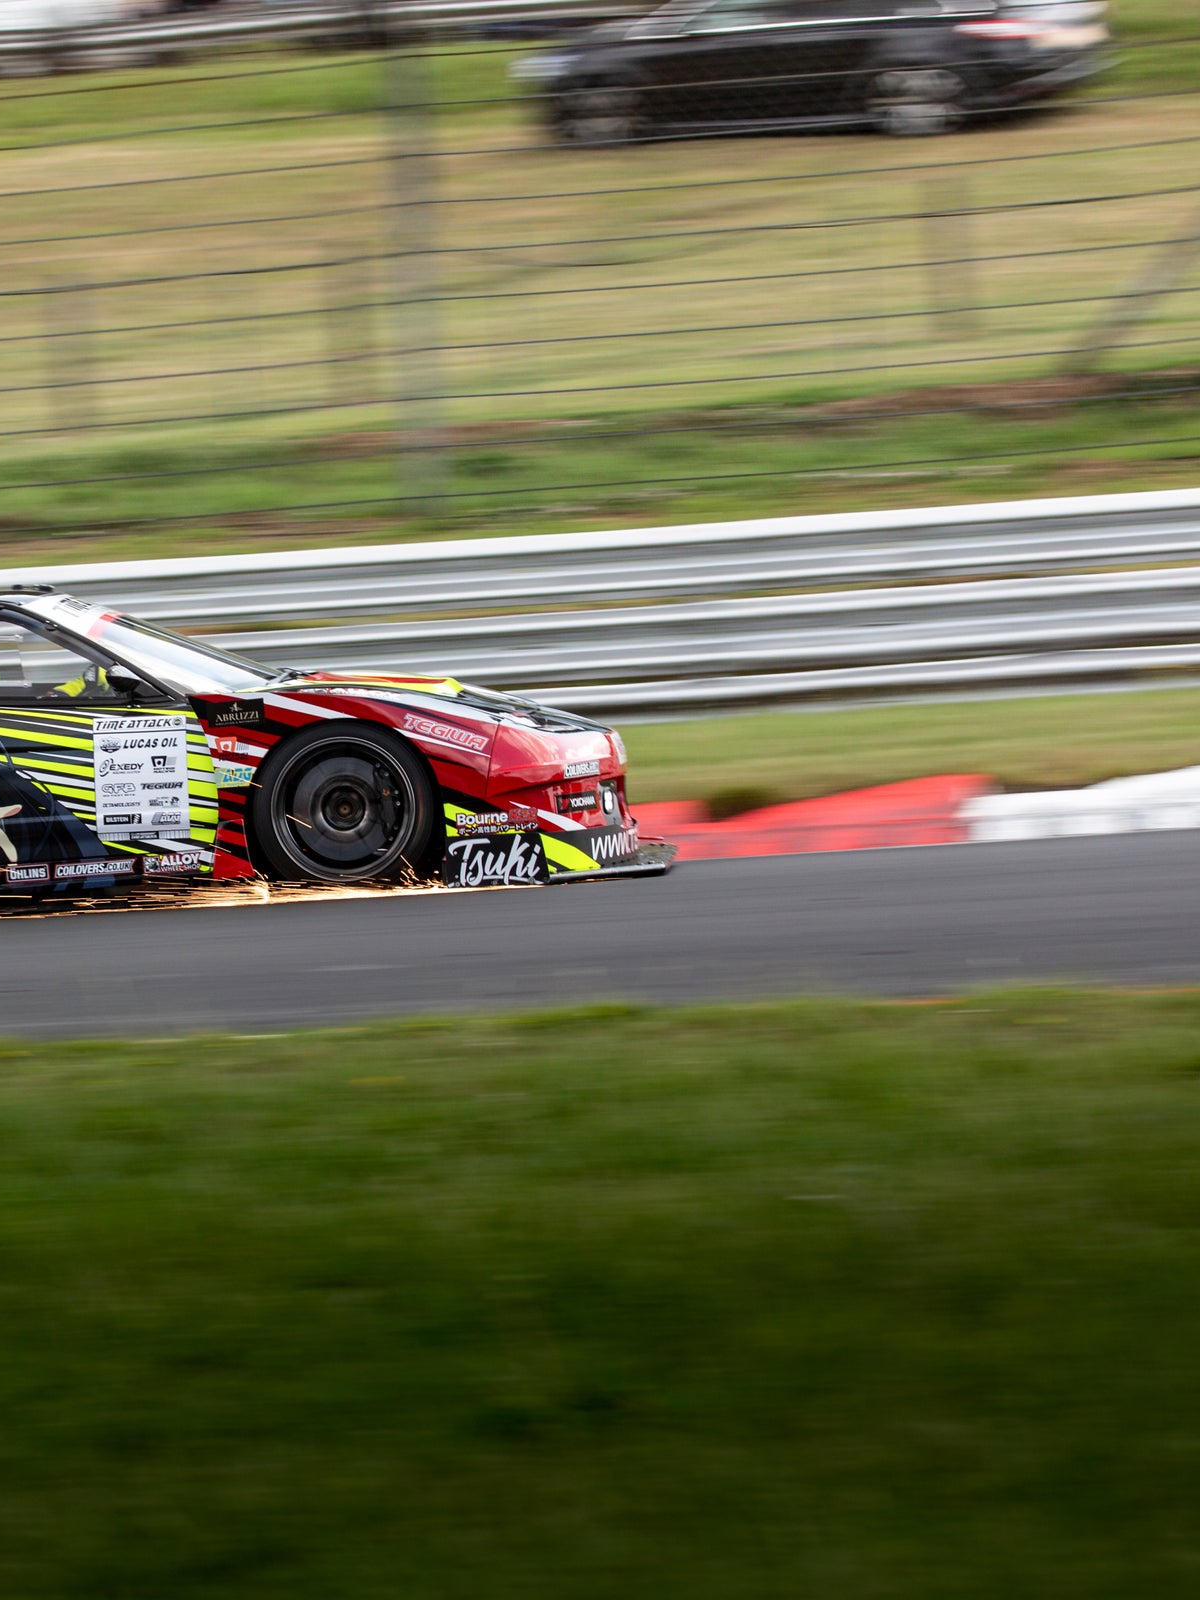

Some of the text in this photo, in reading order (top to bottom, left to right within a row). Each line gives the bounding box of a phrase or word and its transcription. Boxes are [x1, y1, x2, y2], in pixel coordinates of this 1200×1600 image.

[215, 711, 260, 722] ABRUZZI
[404, 713, 490, 751] TEGIWA
[123, 738, 159, 749] LUCAS
[161, 737, 178, 748] OIL
[109, 763, 144, 771] EXEDY
[140, 781, 184, 790] TEGIWA
[456, 812, 509, 826] Bourne
[160, 853, 201, 866] ALLOY
[448, 833, 545, 888] Tsuki
[57, 861, 133, 876] COILOVERS.CO.UK
